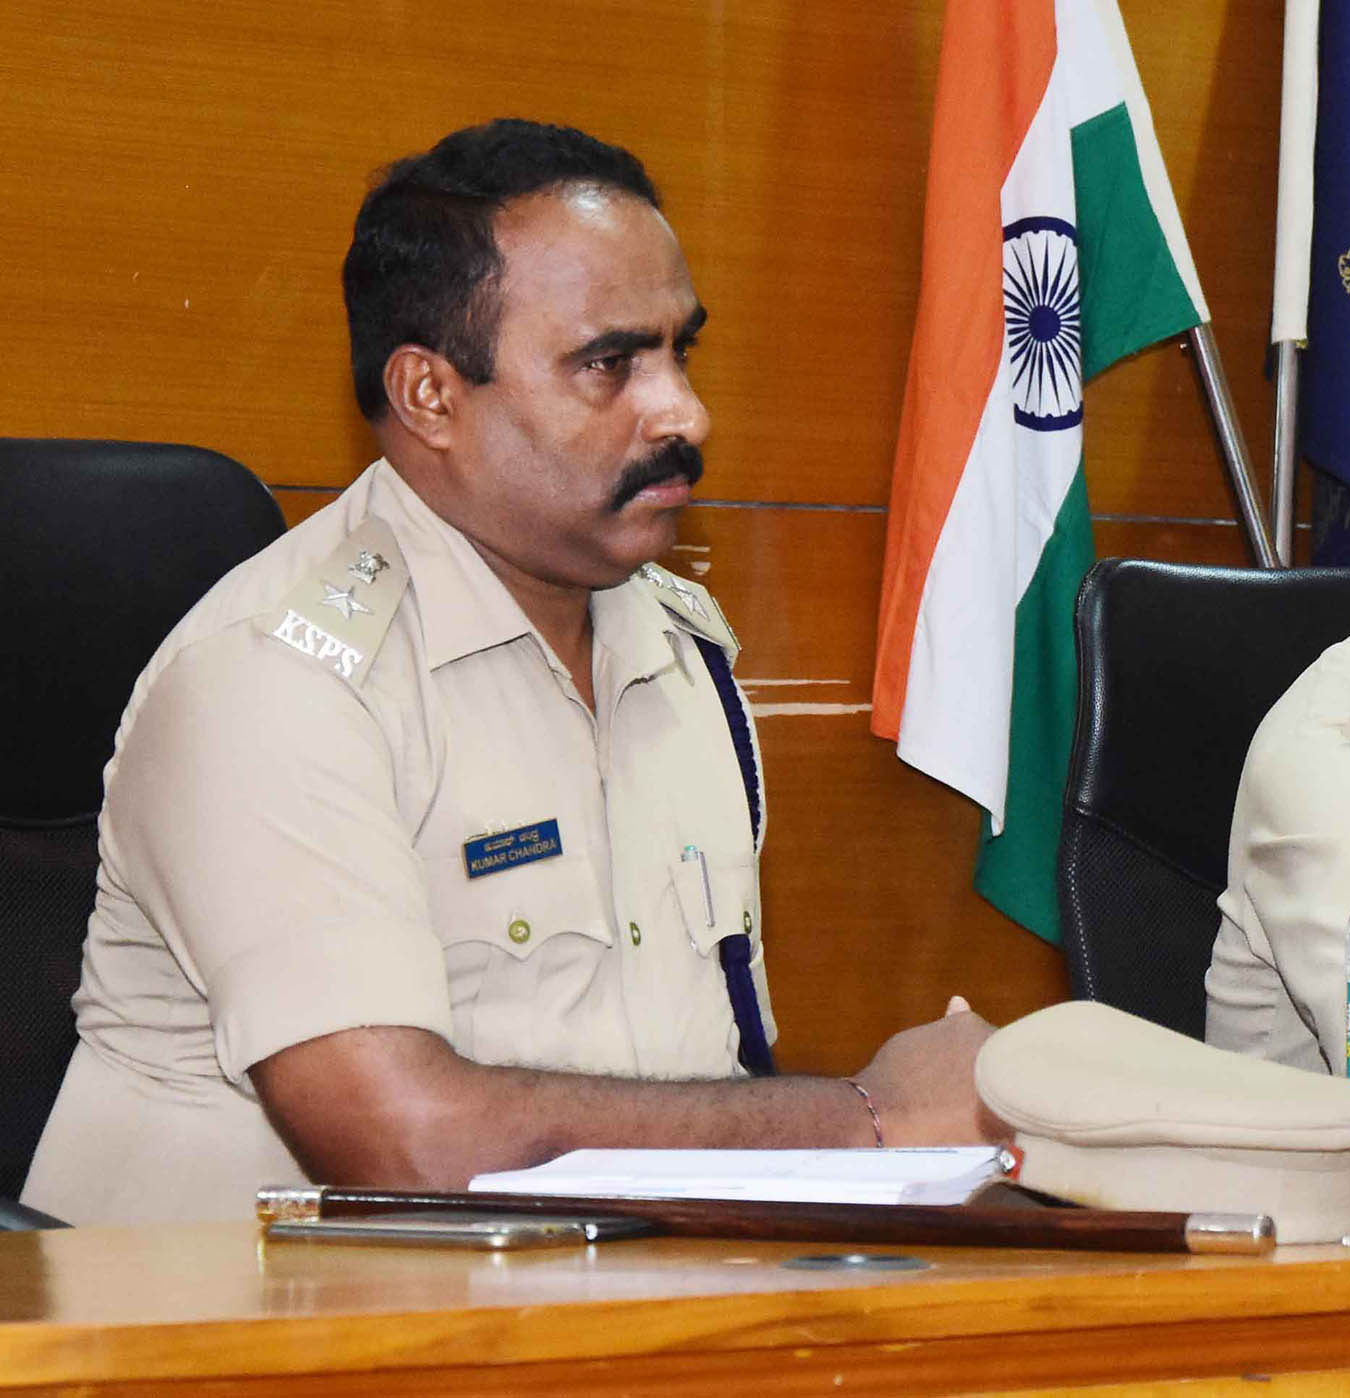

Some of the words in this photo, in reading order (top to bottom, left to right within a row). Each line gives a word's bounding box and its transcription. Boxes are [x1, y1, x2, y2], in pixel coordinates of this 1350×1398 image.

[273, 609, 364, 677] KSPS
[471, 852, 506, 871] KUMAR
[508, 838, 557, 861] CHANDRA
